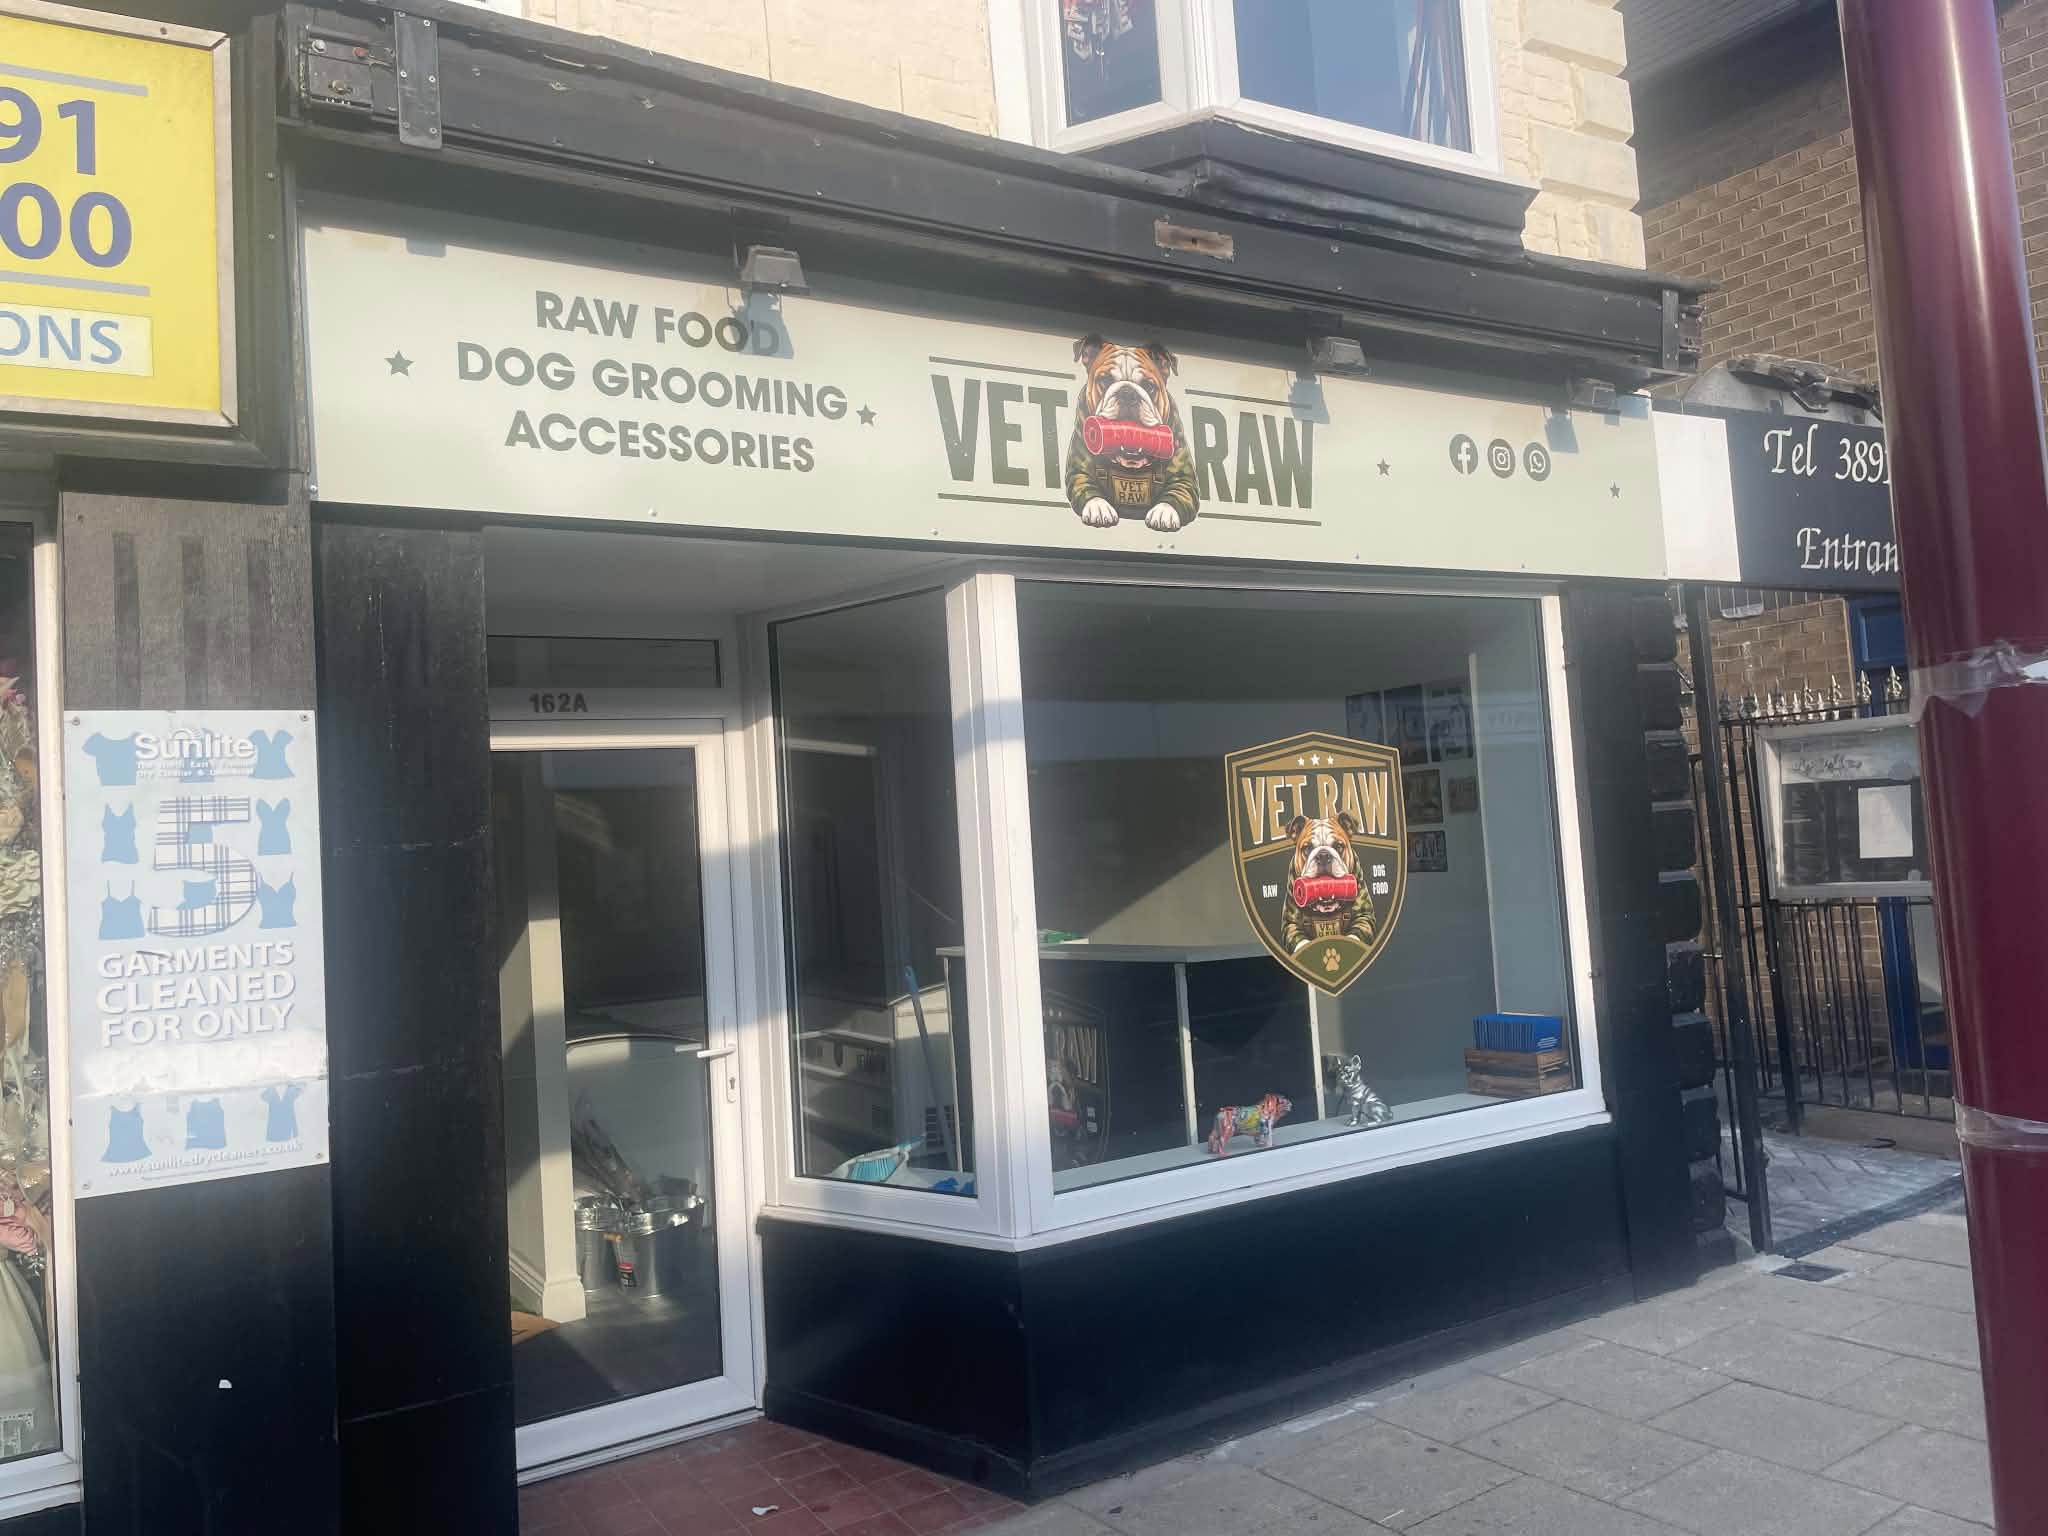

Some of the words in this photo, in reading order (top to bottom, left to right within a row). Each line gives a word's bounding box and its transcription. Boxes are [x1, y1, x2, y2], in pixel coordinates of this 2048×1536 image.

[535, 290, 638, 339] RAW
[655, 307, 780, 356] FOOD
[457, 341, 576, 391] DOG
[591, 358, 848, 420] GROOMING
[504, 410, 815, 473] ACCESSORIES
[930, 374, 1068, 489] VET
[1191, 405, 1314, 509] RAW
[1763, 423, 1819, 477] Tel
[1119, 491, 1146, 504] RAW
[1120, 480, 1144, 492] VET
[1796, 527, 1899, 574] Entran
[529, 692, 589, 713] 162A
[135, 732, 257, 760] Sunlite
[1241, 774, 1308, 845] VET
[1316, 771, 1388, 837] RAW
[147, 795, 258, 938] 5
[1262, 884, 1278, 898] RAW
[1372, 881, 1389, 895] FOOD
[1372, 864, 1386, 878] DOG
[99, 940, 296, 980] GARMENTS
[97, 968, 297, 1016] CLEANED
[101, 1012, 182, 1048] FOR
[192, 1002, 295, 1039] ONLY
